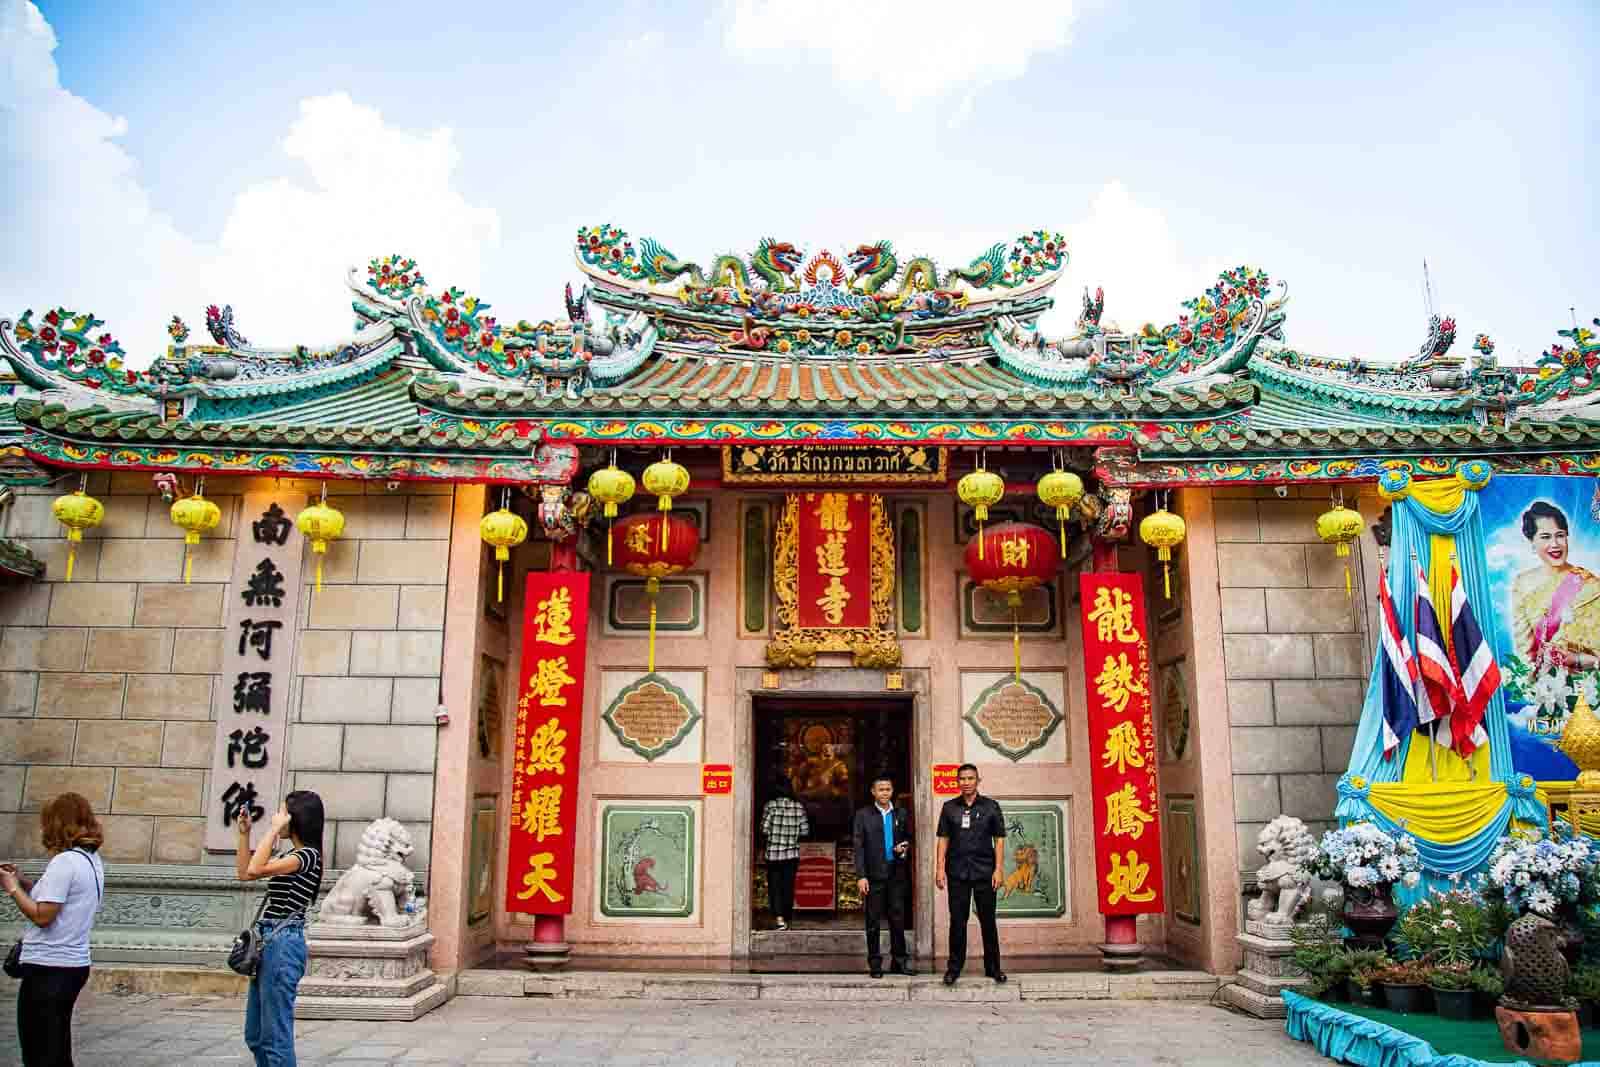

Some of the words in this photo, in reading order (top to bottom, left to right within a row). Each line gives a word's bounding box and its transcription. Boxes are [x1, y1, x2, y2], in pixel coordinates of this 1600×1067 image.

[814, 492, 853, 624] 龍蓮寺
[1001, 538, 1030, 568] 財
[221, 503, 293, 827] 南無阿彌陀佛
[517, 587, 577, 903] 蓮燈照耀天
[706, 780, 729, 789] 出口
[936, 780, 958, 789] 入口
[1088, 587, 1156, 906] 龍勢飛騰地
